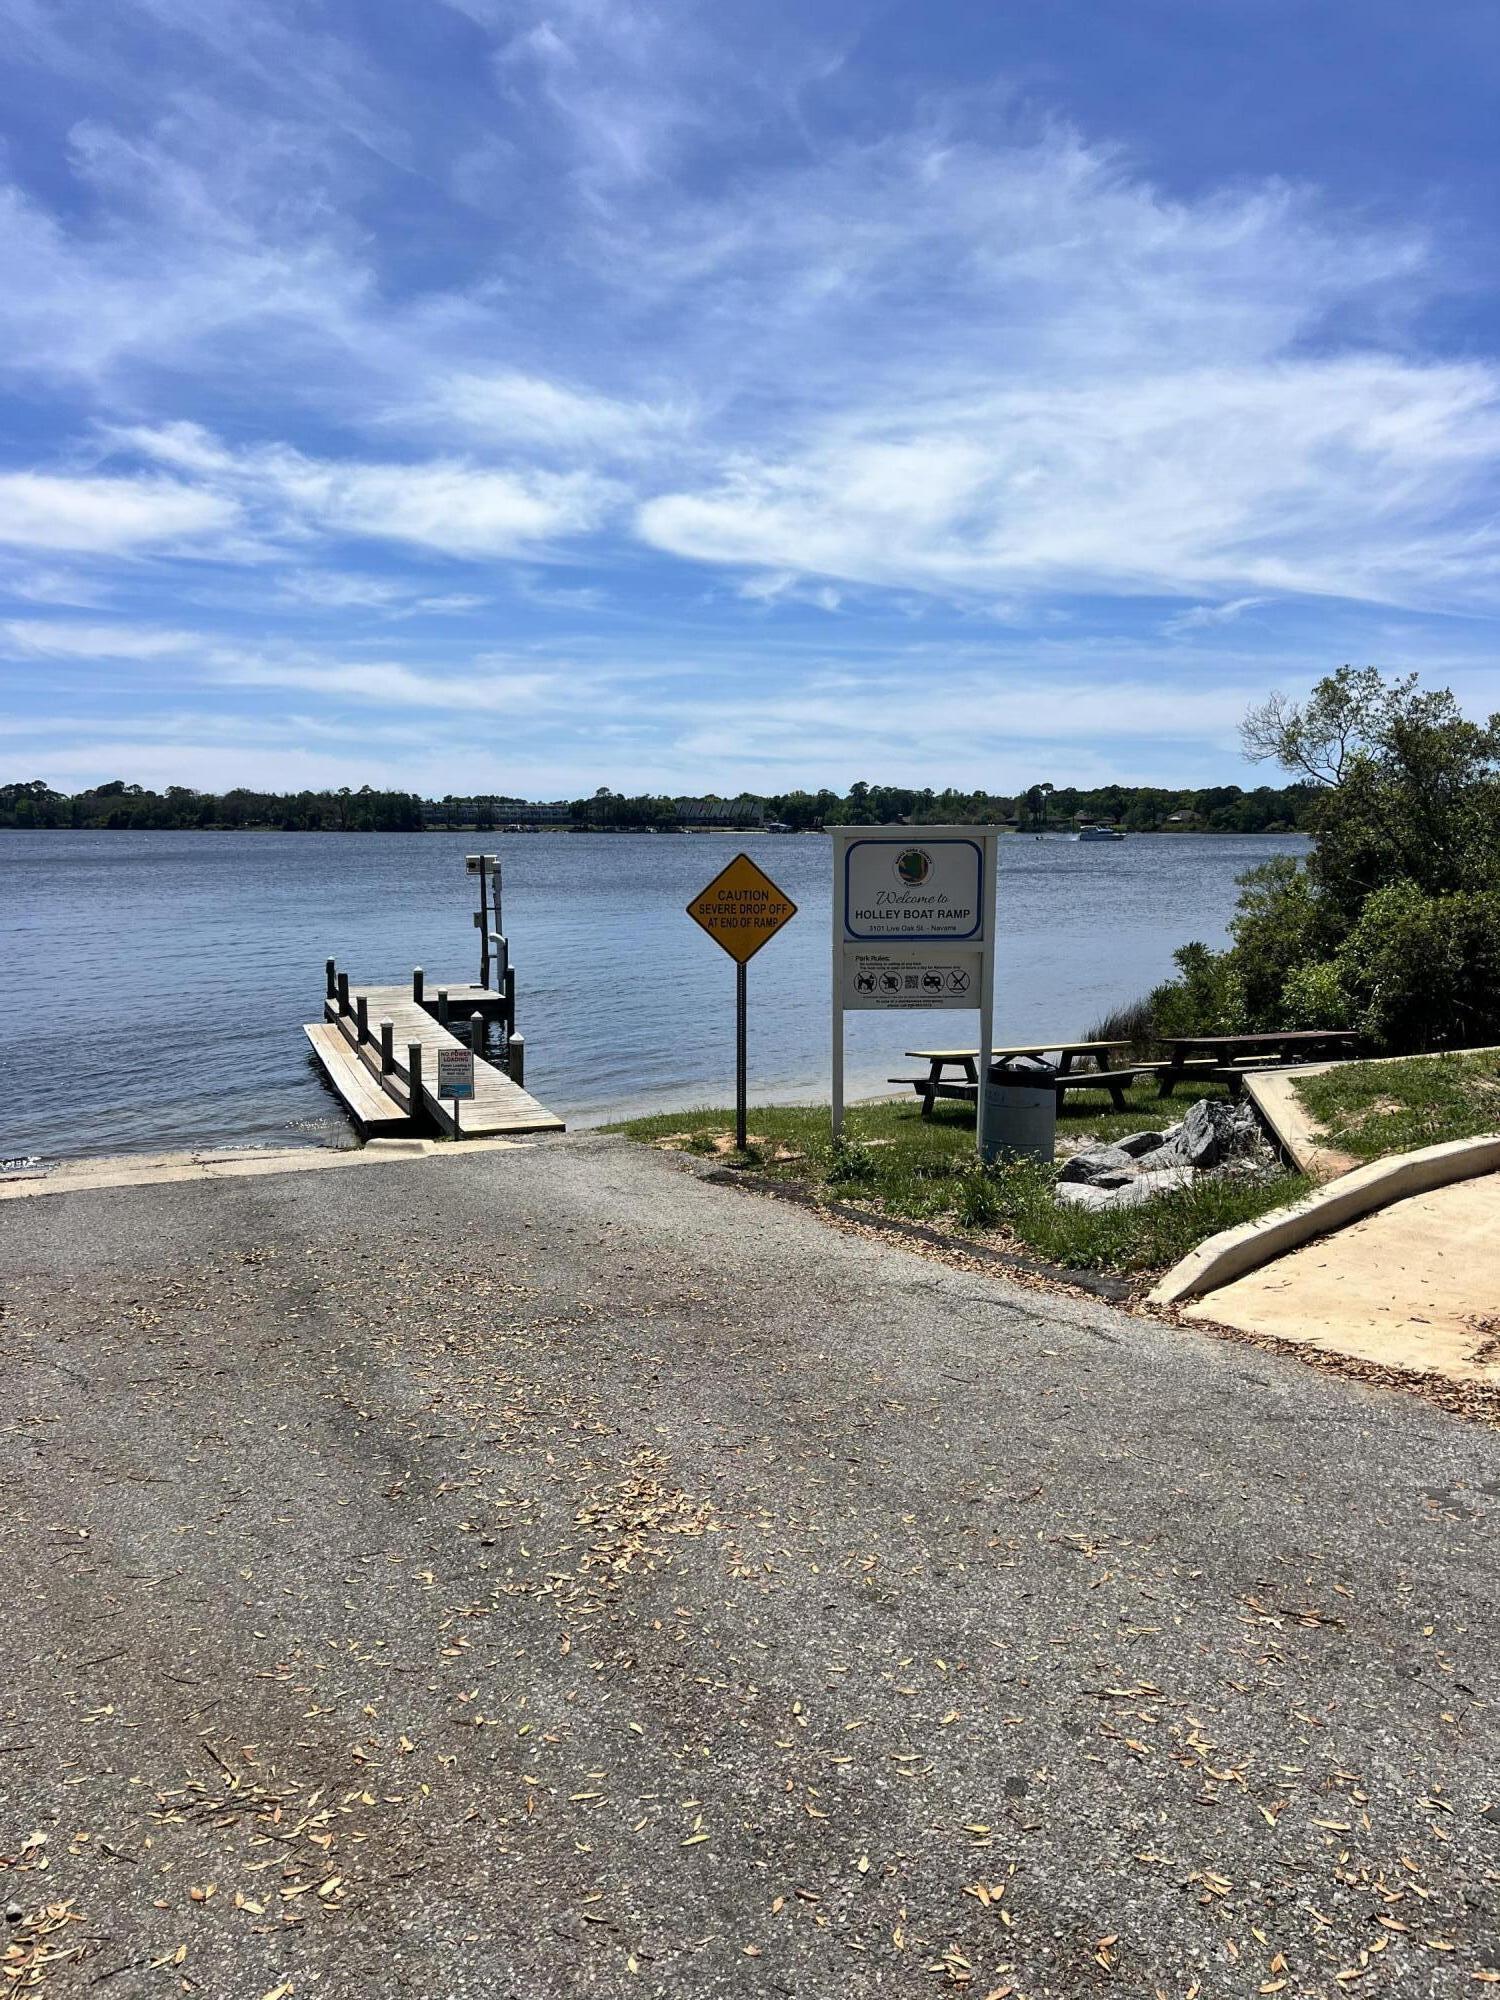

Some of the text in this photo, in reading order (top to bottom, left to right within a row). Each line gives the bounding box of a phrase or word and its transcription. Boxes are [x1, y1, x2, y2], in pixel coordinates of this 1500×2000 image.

[718, 890, 769, 901] CAUTION
[875, 889, 949, 905] Welcome to
[699, 903, 788, 915] SEVERE DROP OFF
[855, 909, 971, 919] HOLLEY BOAT RAMP
[707, 918, 779, 928] AT END OF RAMP
